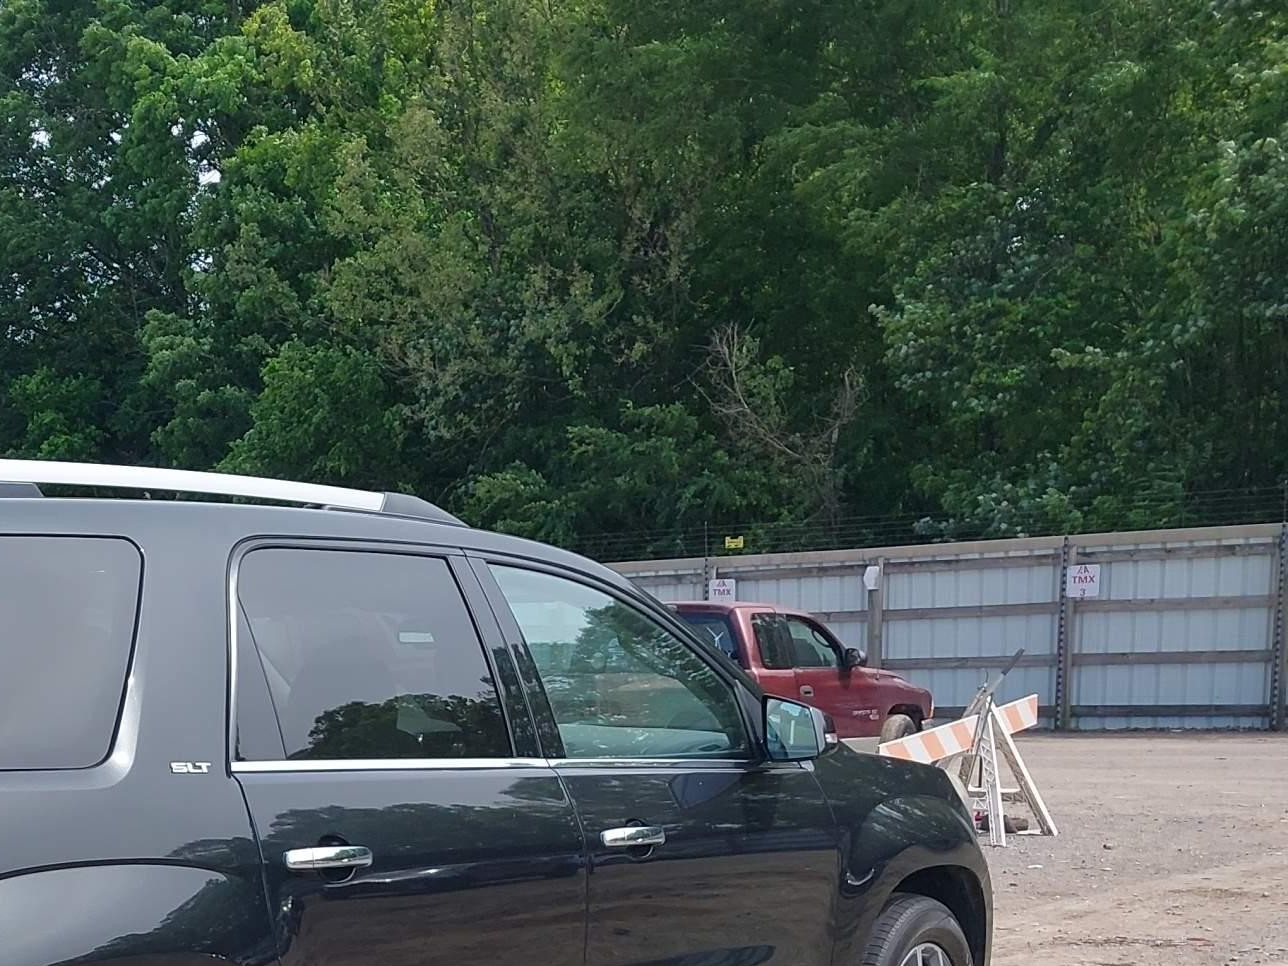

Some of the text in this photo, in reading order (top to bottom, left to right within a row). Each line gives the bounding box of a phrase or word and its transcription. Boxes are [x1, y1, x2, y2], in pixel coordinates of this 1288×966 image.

[1072, 575, 1095, 584] TMX
[712, 588, 732, 596] TMX
[1079, 588, 1086, 597] 3
[170, 761, 212, 774] SLT
